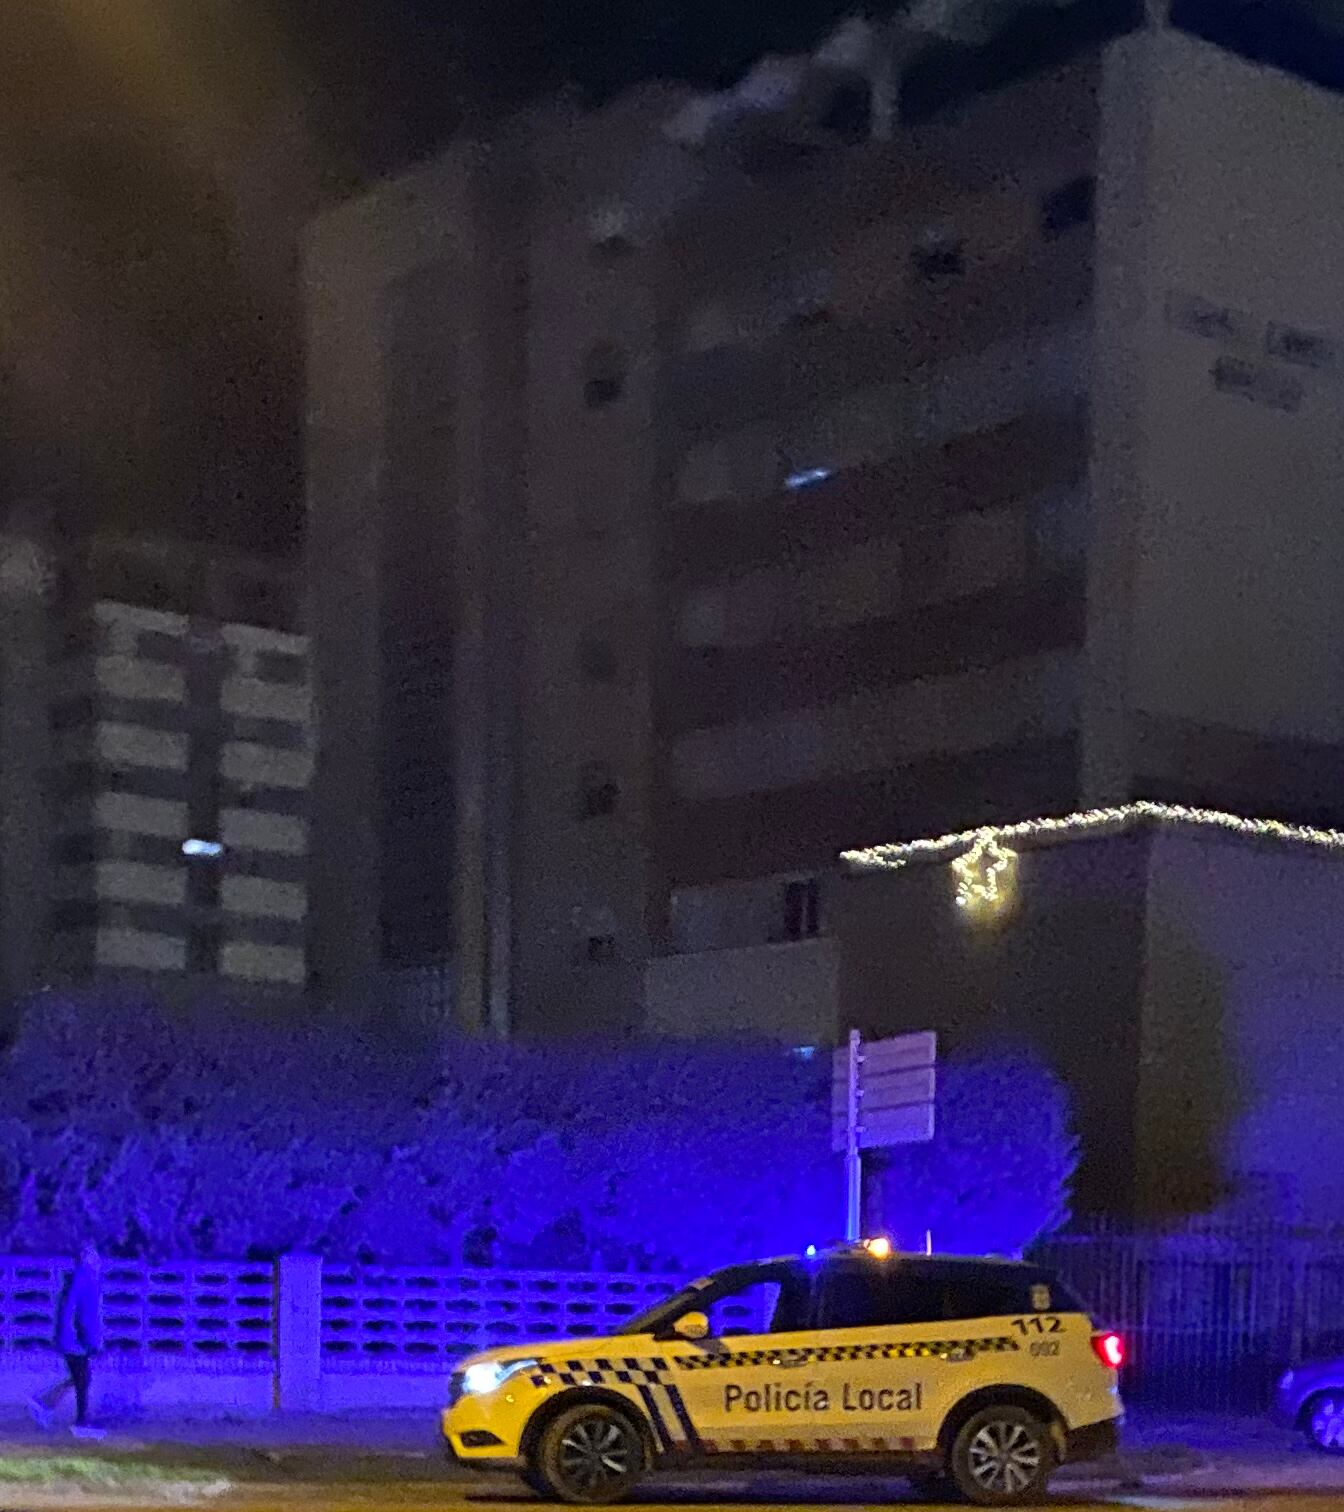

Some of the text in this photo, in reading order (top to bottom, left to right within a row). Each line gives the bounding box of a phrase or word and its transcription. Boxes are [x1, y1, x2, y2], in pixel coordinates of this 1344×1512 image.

[1011, 1315, 1067, 1335] 112
[725, 1381, 922, 1412] Policía Local
